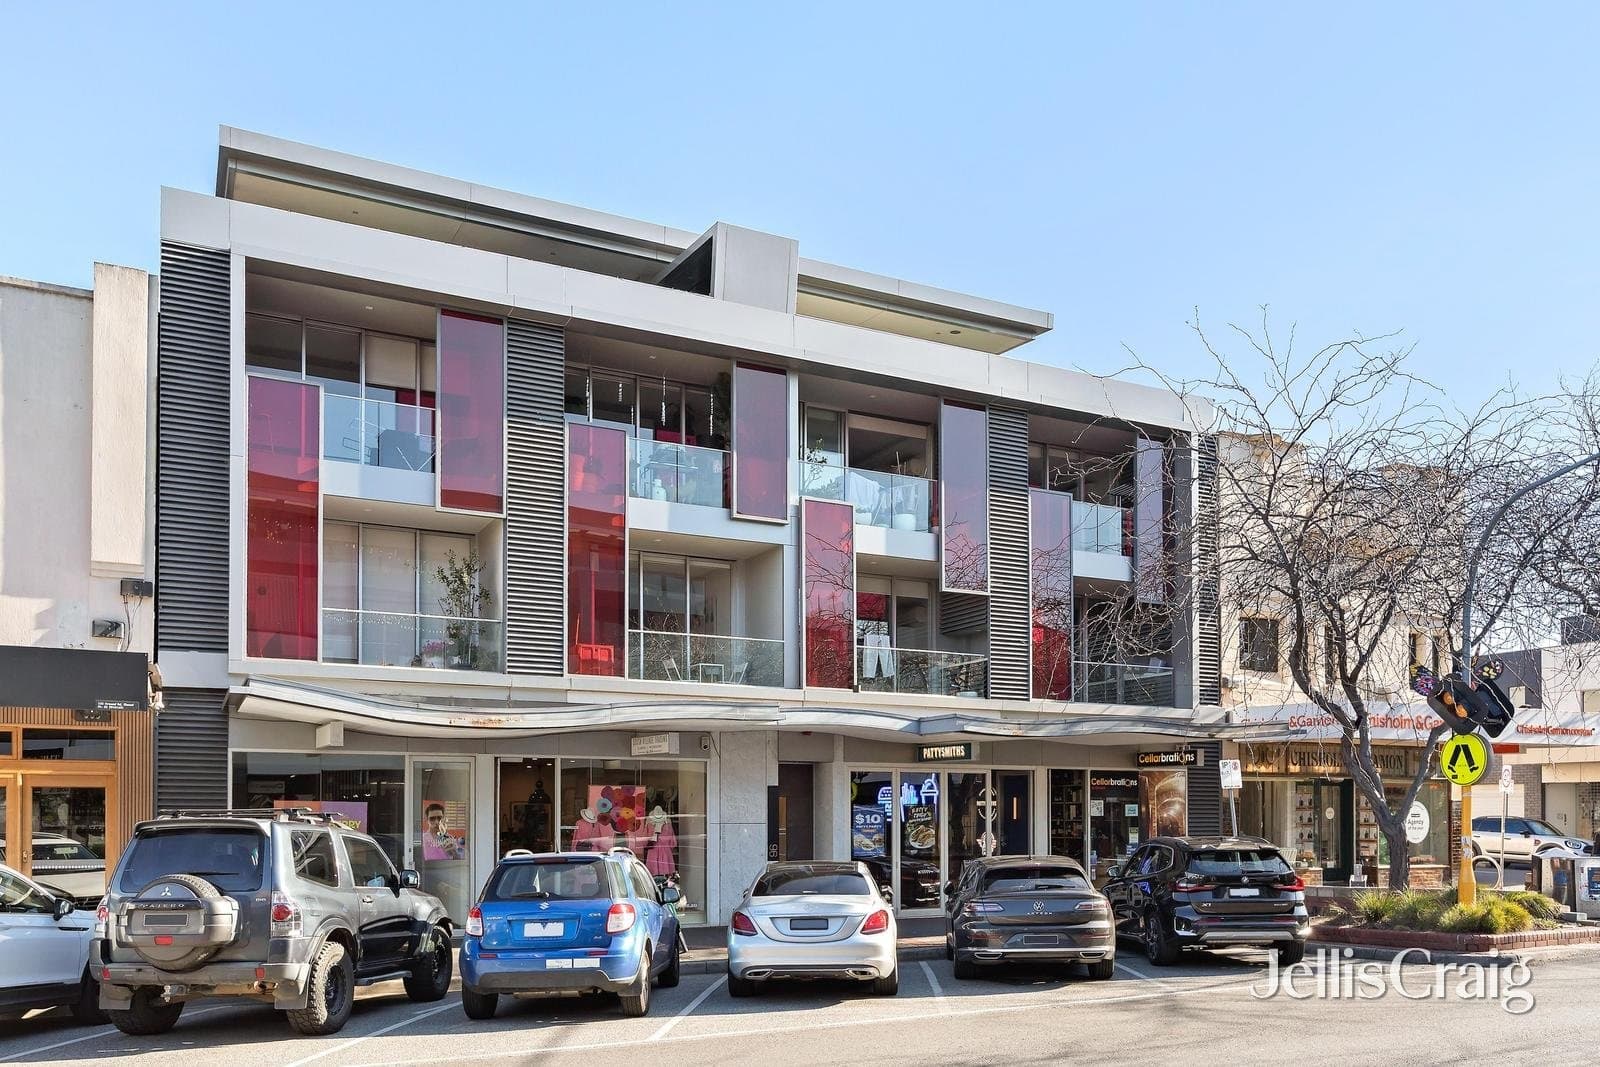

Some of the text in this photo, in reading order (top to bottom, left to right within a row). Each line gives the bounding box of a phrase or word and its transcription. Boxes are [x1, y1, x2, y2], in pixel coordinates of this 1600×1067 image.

[923, 745, 965, 759] PATTYSMITHS
[1138, 751, 1195, 764] Cellarbrations
[1291, 751, 1343, 767] CHISHOL
[1372, 753, 1404, 769] AMON
[1091, 777, 1138, 787] Cellarbrations
[855, 813, 881, 824] $10
